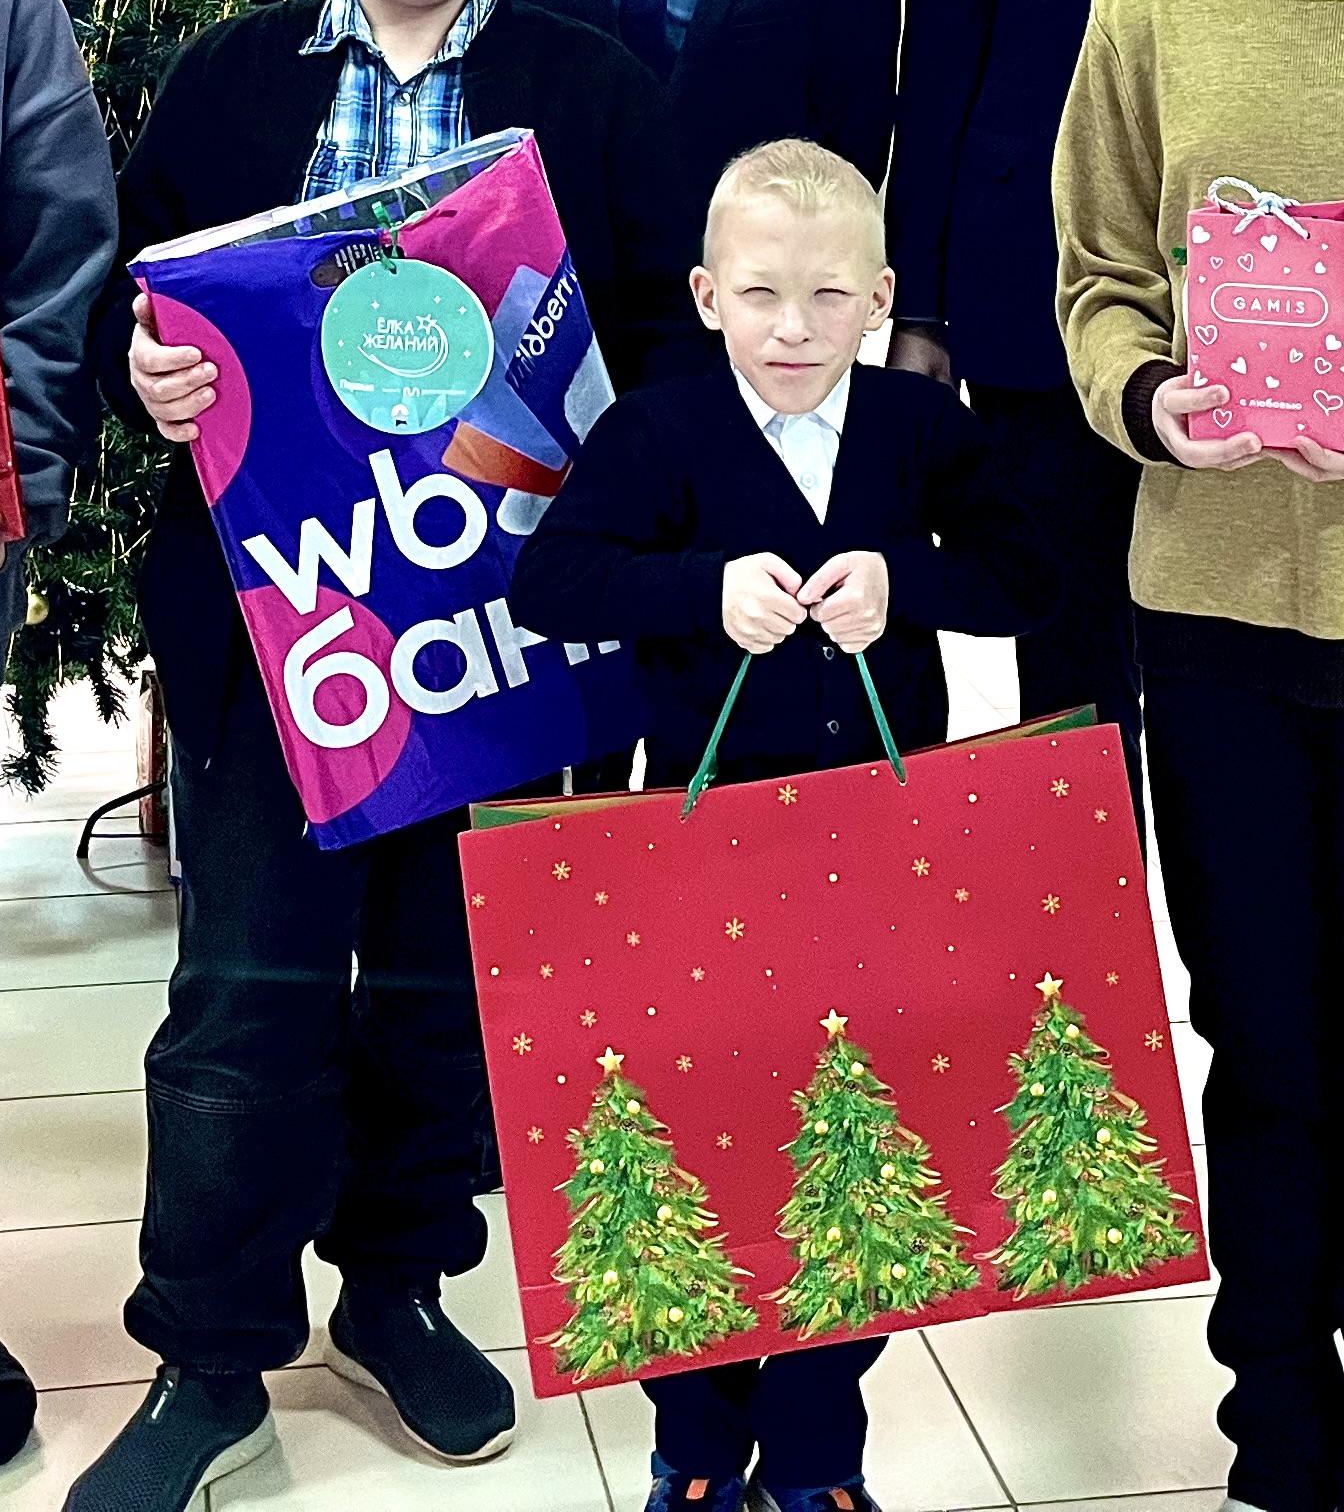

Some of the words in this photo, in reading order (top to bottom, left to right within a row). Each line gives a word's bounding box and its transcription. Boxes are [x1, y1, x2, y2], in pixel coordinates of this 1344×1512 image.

[362, 333, 440, 354] ЖЕЛАНИЙ
[1233, 296, 1306, 315] GAMIS
[241, 448, 488, 616] wb
[283, 597, 622, 750] бан
